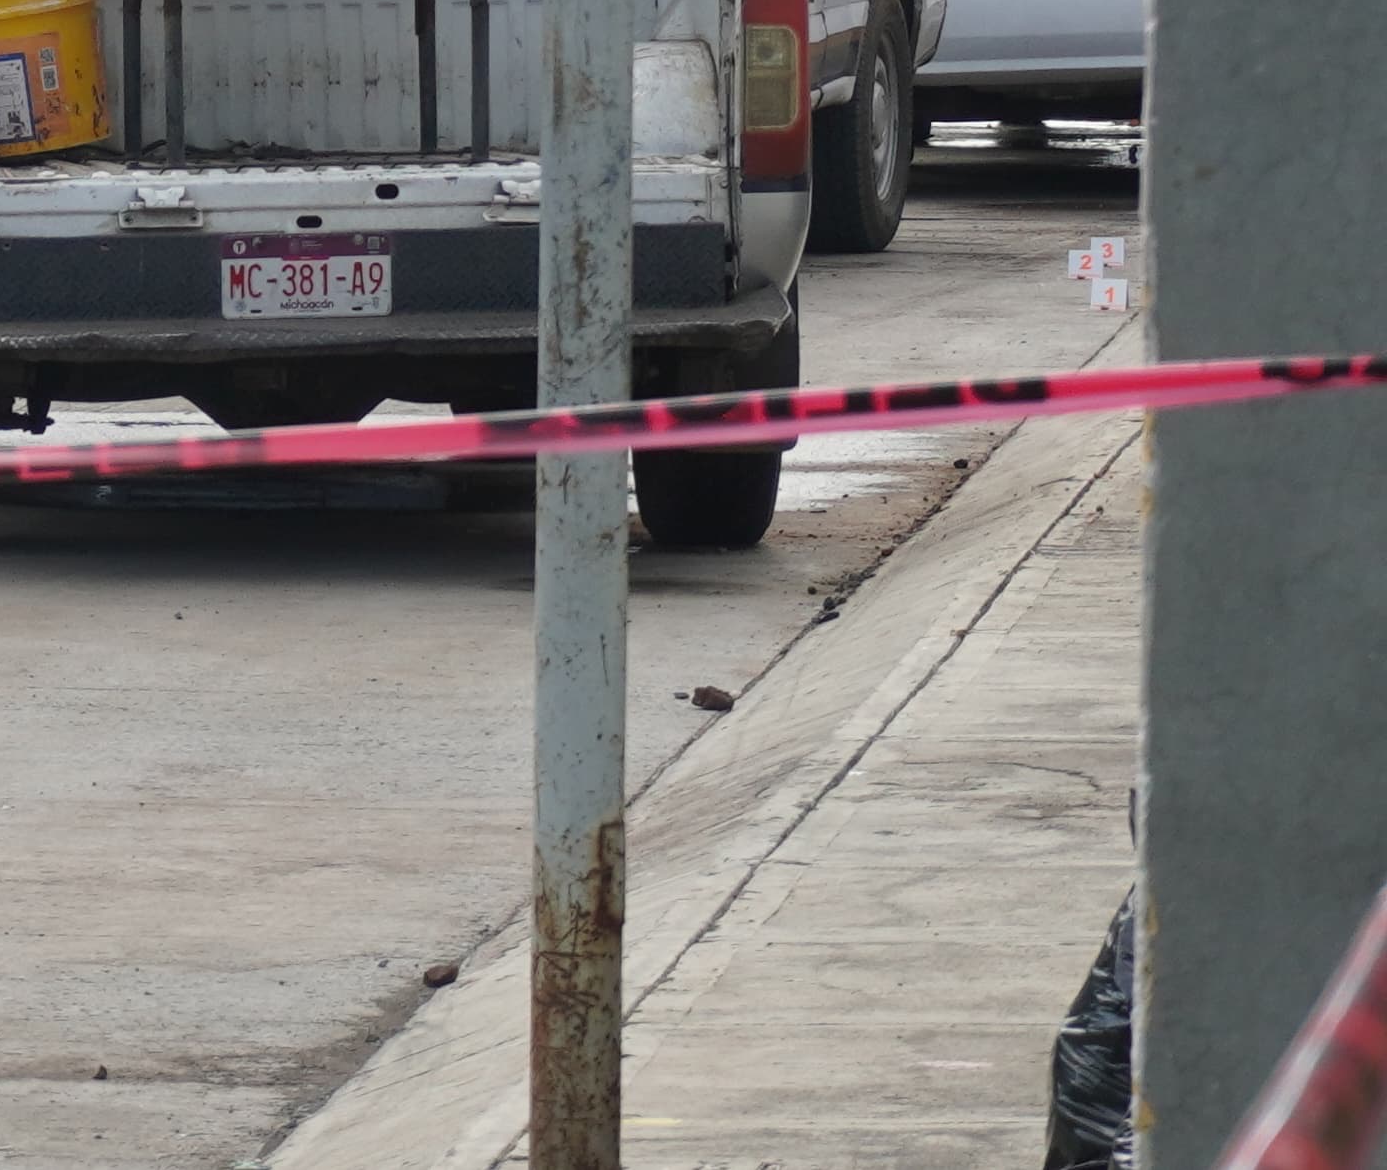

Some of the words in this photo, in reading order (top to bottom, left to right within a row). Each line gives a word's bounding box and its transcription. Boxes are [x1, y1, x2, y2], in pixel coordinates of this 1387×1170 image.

[1101, 242, 1114, 259] 3
[1080, 254, 1092, 270] 2
[229, 261, 384, 300] MC-381-A9
[1104, 286, 1115, 303] 1
